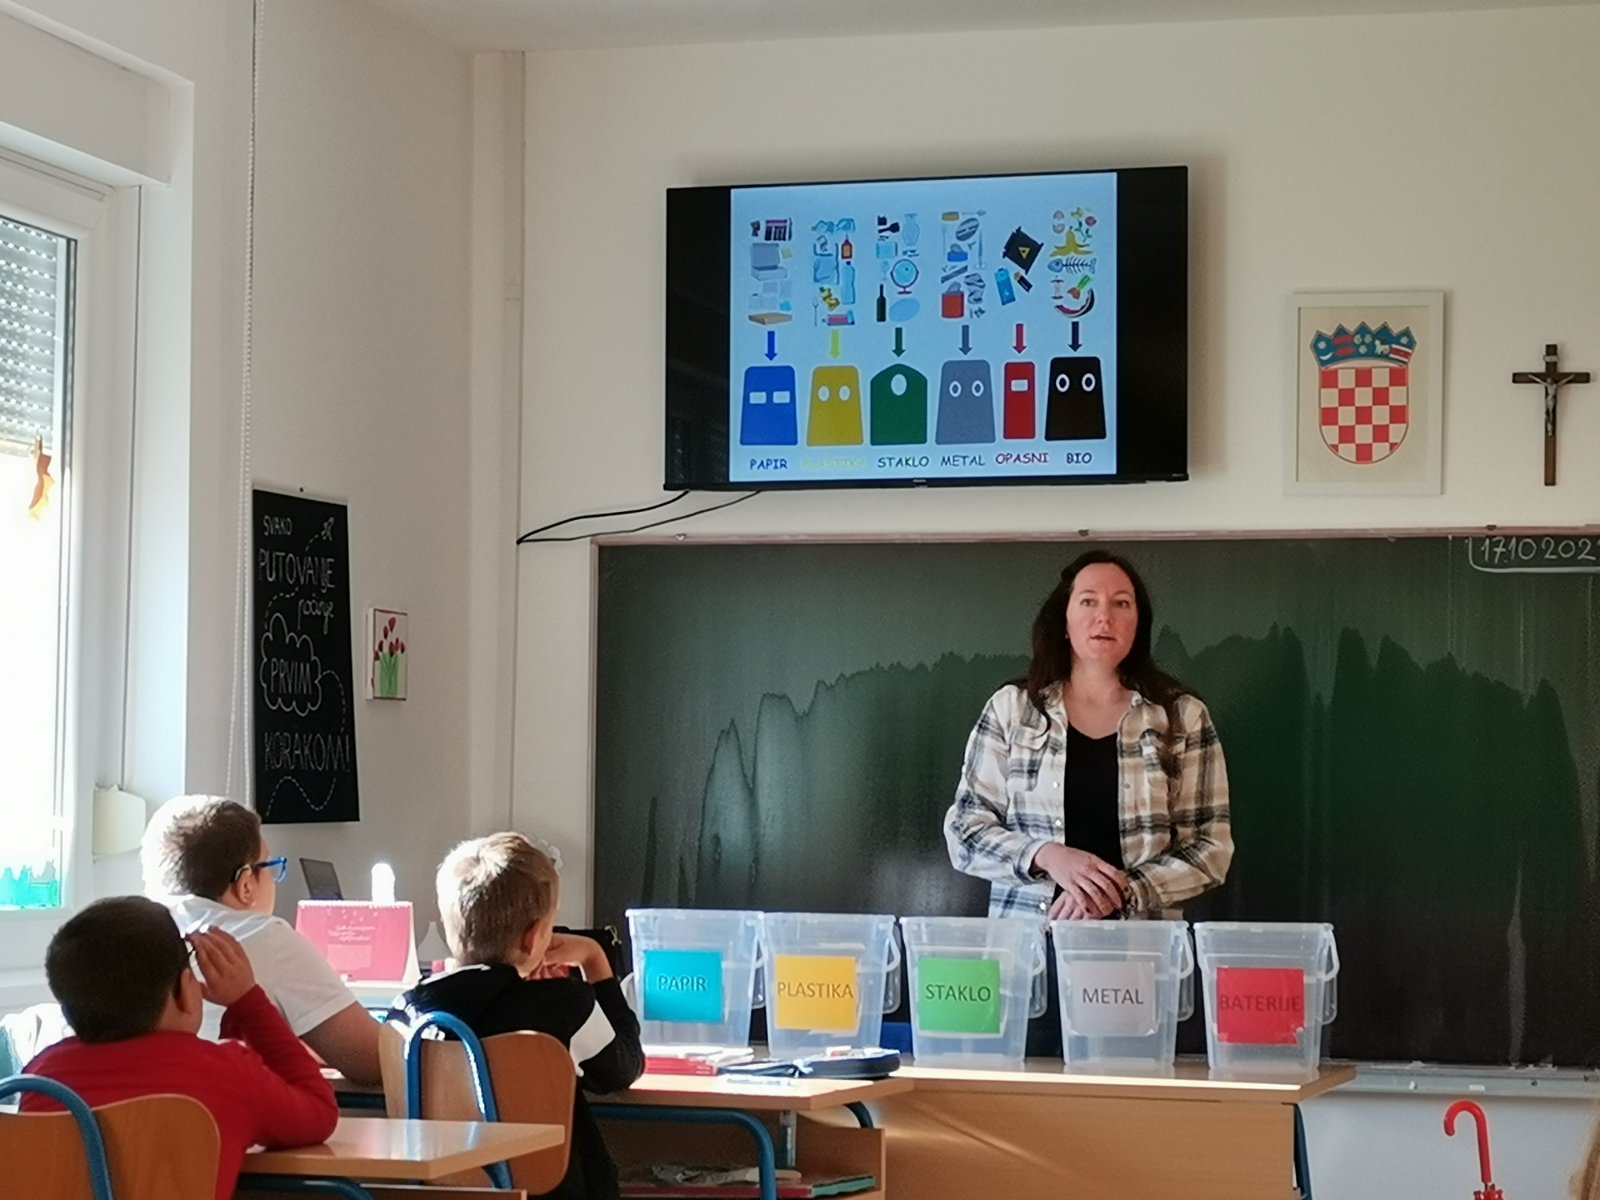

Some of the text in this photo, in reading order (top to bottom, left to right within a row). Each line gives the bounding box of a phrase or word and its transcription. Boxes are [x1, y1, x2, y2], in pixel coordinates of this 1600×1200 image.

[749, 457, 789, 470] PAPIR
[877, 455, 930, 468] STAKLO
[940, 454, 986, 466] METAL
[995, 451, 1049, 465] OPASNI
[1066, 452, 1092, 464] BIO
[263, 515, 293, 536] SVAKO
[258, 548, 336, 593] PUTOVANJE
[270, 657, 312, 695] PRVIM
[658, 975, 707, 992] PAPIR
[777, 981, 854, 999] PLASTIKA
[925, 983, 991, 1002] STAKLO
[1082, 987, 1144, 1005] METAL
[1220, 994, 1301, 1012] BATERIJE
